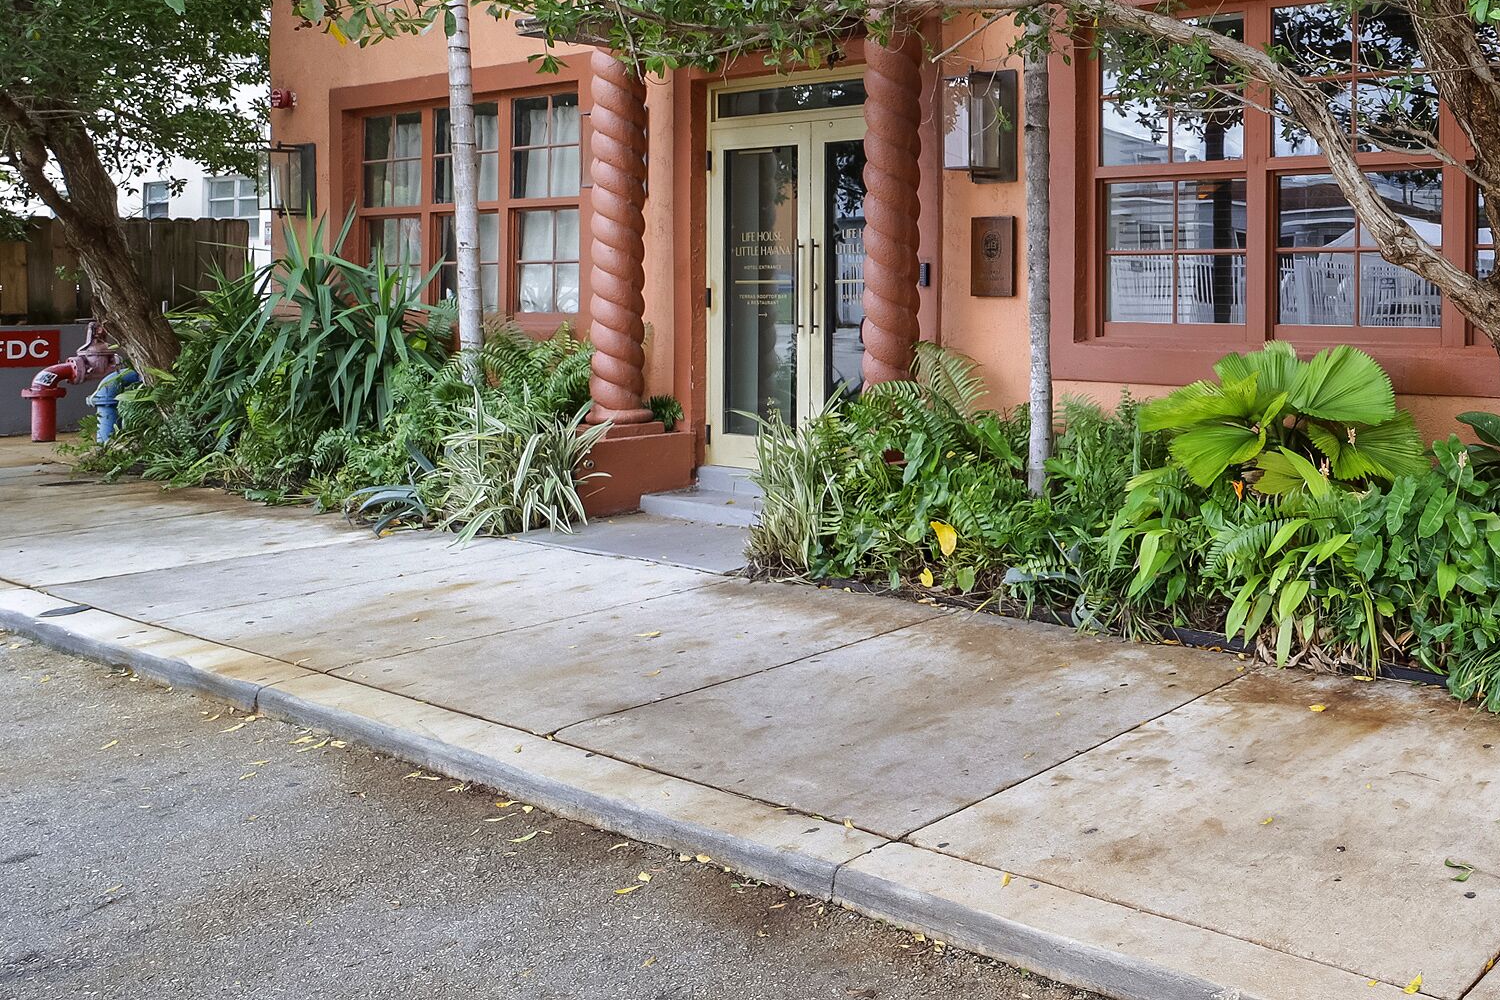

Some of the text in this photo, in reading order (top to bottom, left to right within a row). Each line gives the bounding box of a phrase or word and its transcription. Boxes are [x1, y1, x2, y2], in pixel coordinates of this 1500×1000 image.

[741, 232, 756, 242] LIFE
[842, 229, 857, 239] LIFE
[735, 246, 792, 257] LITTLE HAVANA
[836, 243, 861, 255] LITTLE
[0, 339, 49, 360] DC
